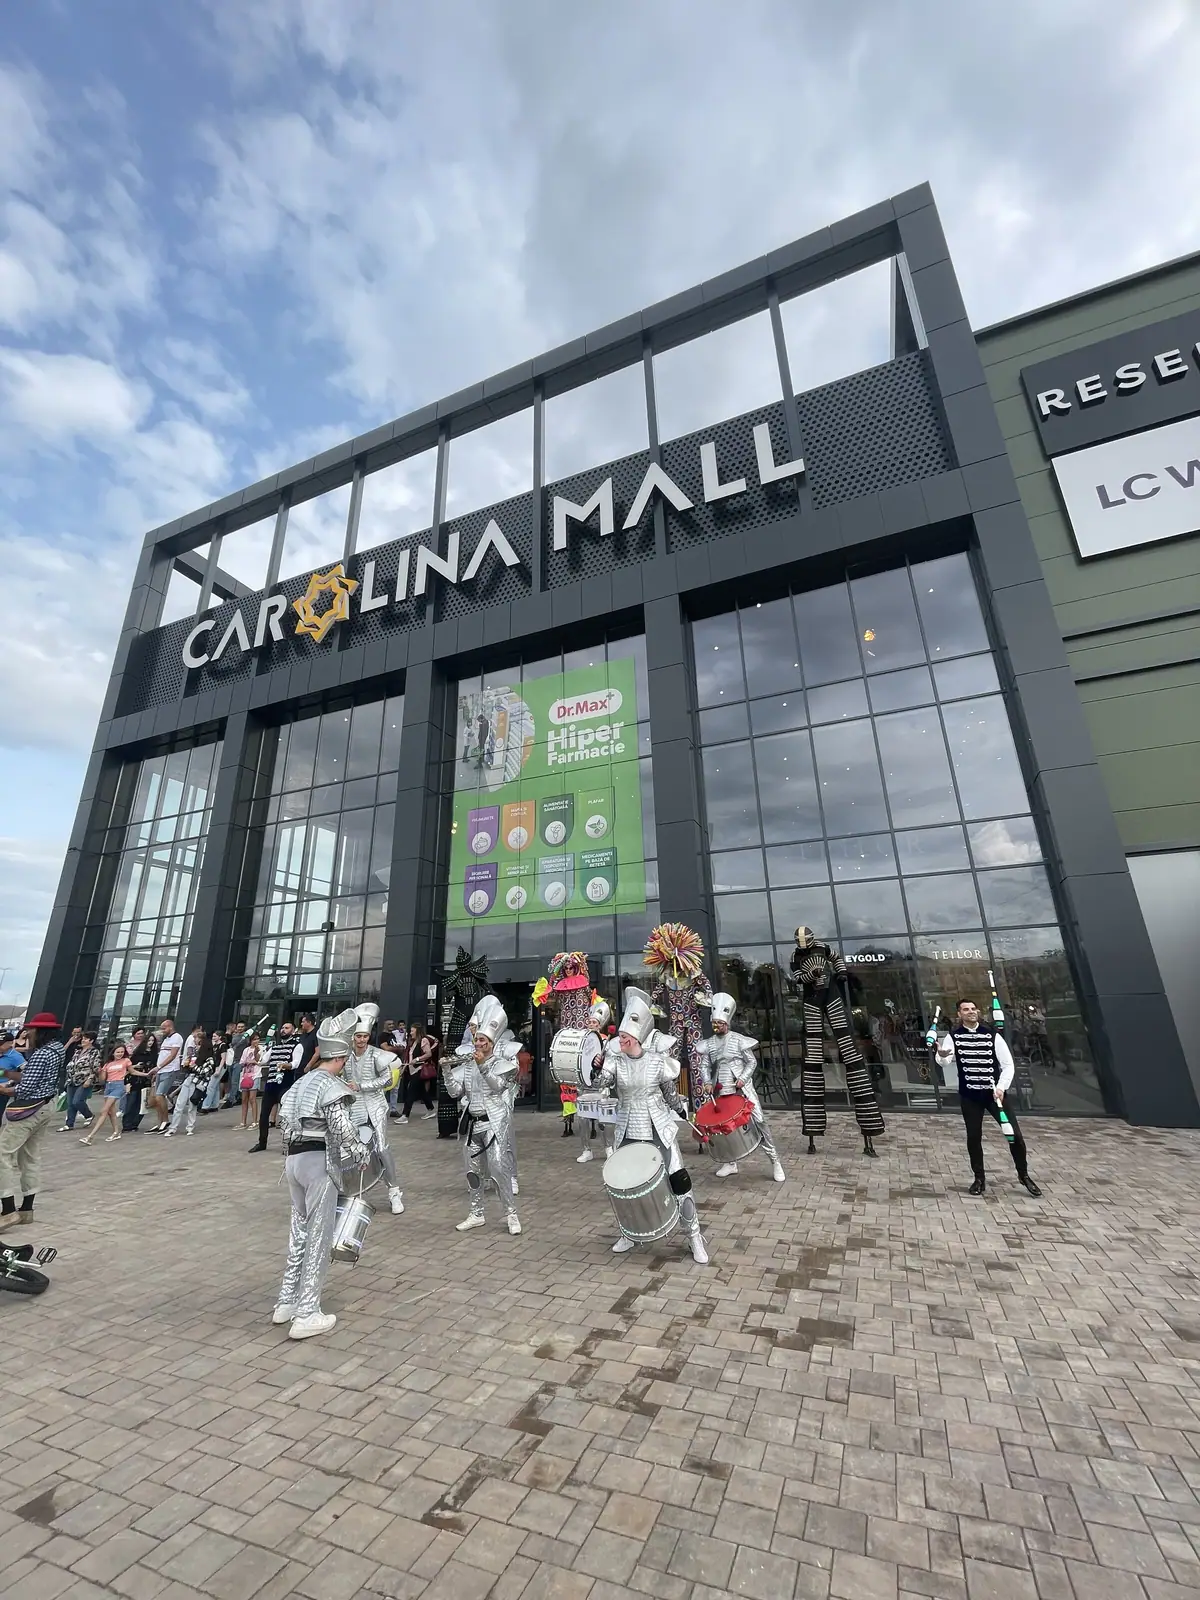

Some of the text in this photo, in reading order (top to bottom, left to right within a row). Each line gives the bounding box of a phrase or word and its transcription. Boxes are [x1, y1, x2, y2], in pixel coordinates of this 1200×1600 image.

[1037, 341, 1200, 415] RESE
[553, 422, 806, 551] MALL
[1095, 473, 1162, 510] LC
[547, 721, 625, 752] Hiper
[547, 740, 626, 766] Farmacie
[932, 949, 982, 960] TEILOR
